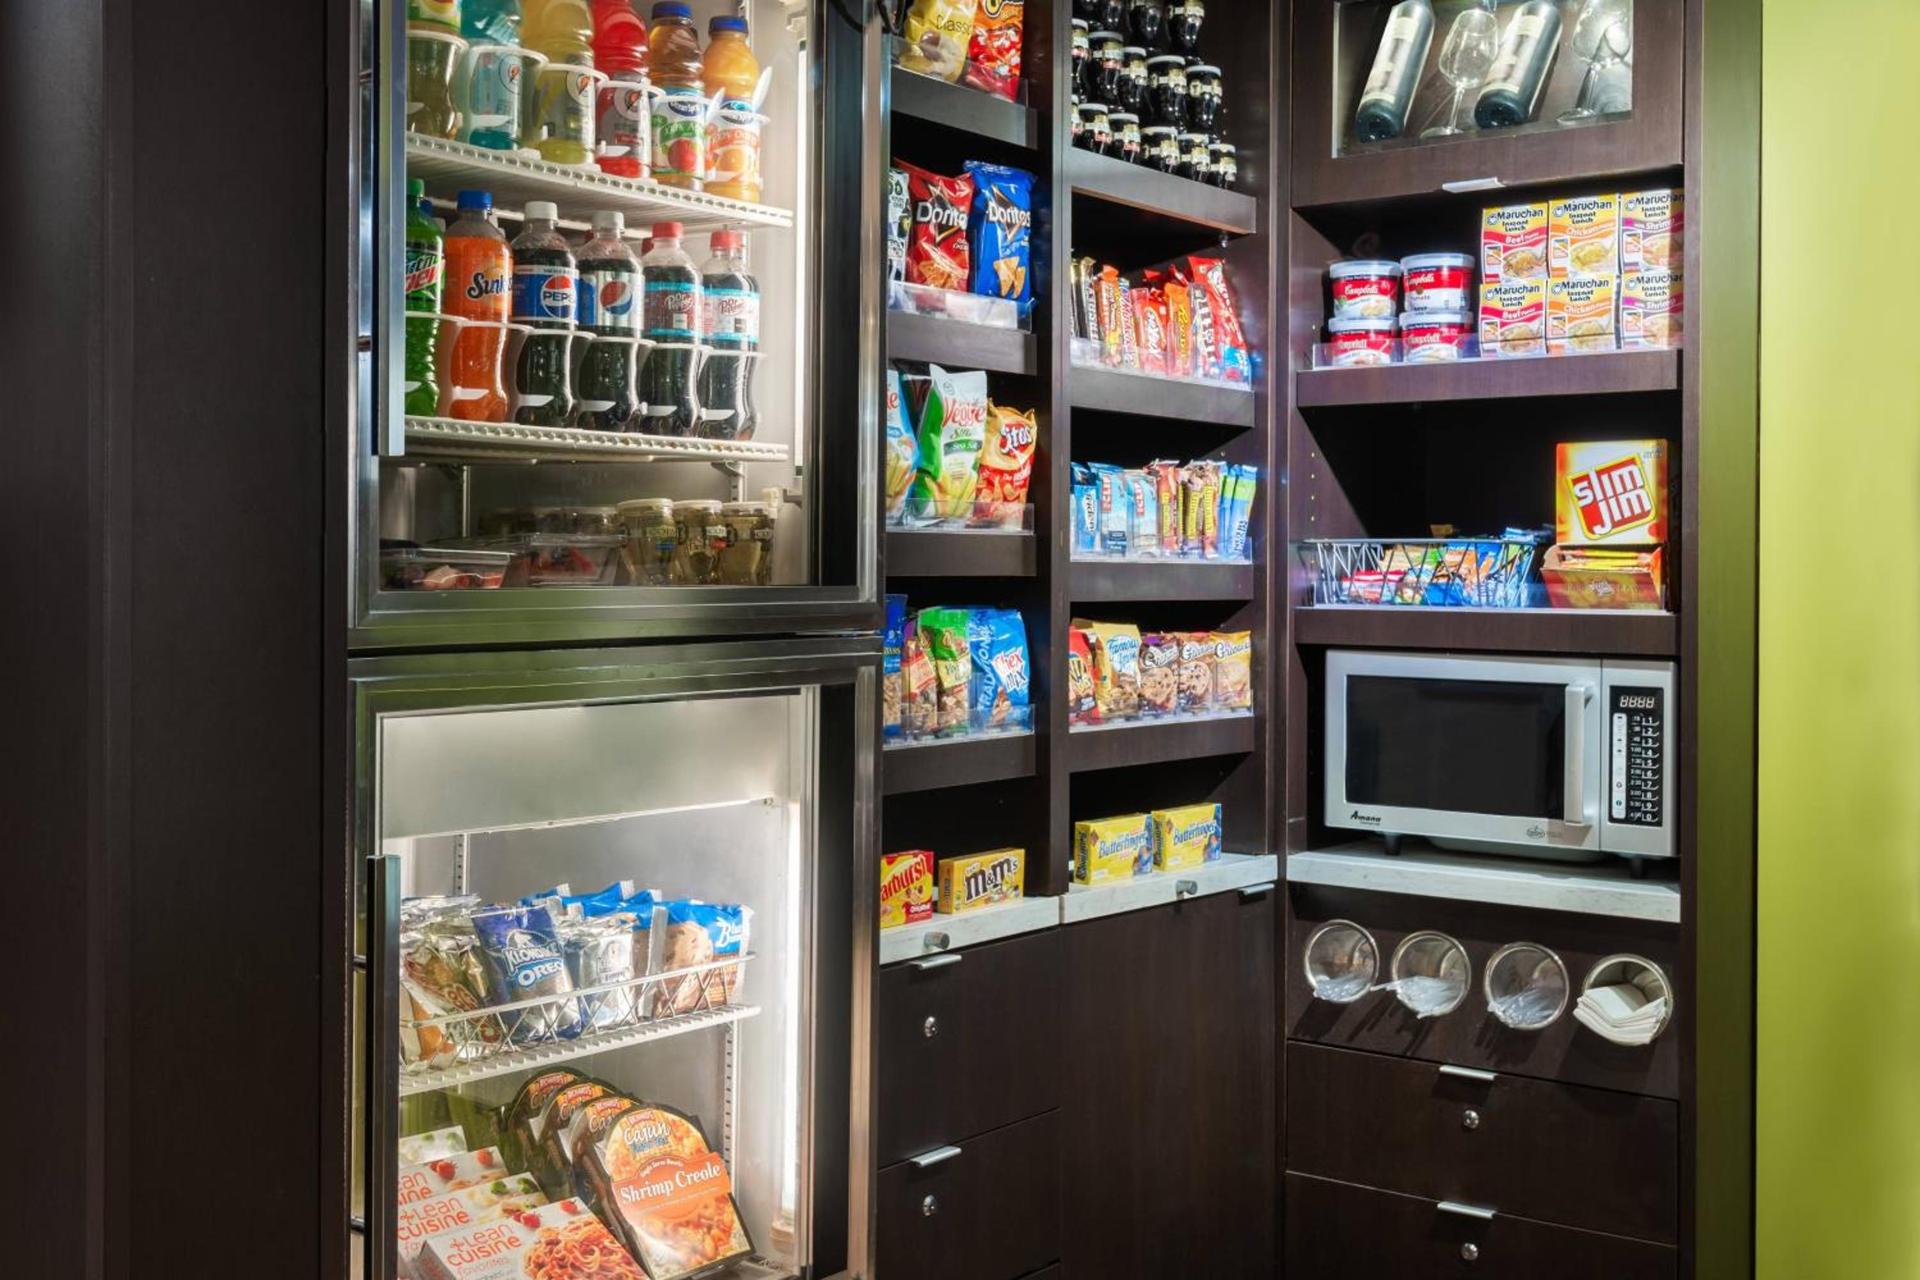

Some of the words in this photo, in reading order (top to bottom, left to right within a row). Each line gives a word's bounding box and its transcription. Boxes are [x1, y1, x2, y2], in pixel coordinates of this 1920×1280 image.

[916, 201, 968, 231] Dorito
[987, 200, 1031, 227] Doritos
[1497, 209, 1543, 220] Maruchan
[1563, 200, 1612, 213] Maruchan
[1494, 285, 1540, 296] Maruchan
[1562, 279, 1609, 290] Maruchan
[1636, 274, 1684, 284] Marucha
[880, 856, 926, 902] arburst
[518, 961, 564, 987] OREO
[623, 1121, 671, 1145] Cajun
[620, 1180, 674, 1204] Shrimp
[675, 1162, 721, 1188] Creole
[413, 1197, 463, 1220] Lean
[397, 1211, 471, 1241] cuisine
[463, 1224, 514, 1248] Lean
[447, 1236, 522, 1267] cuisine
